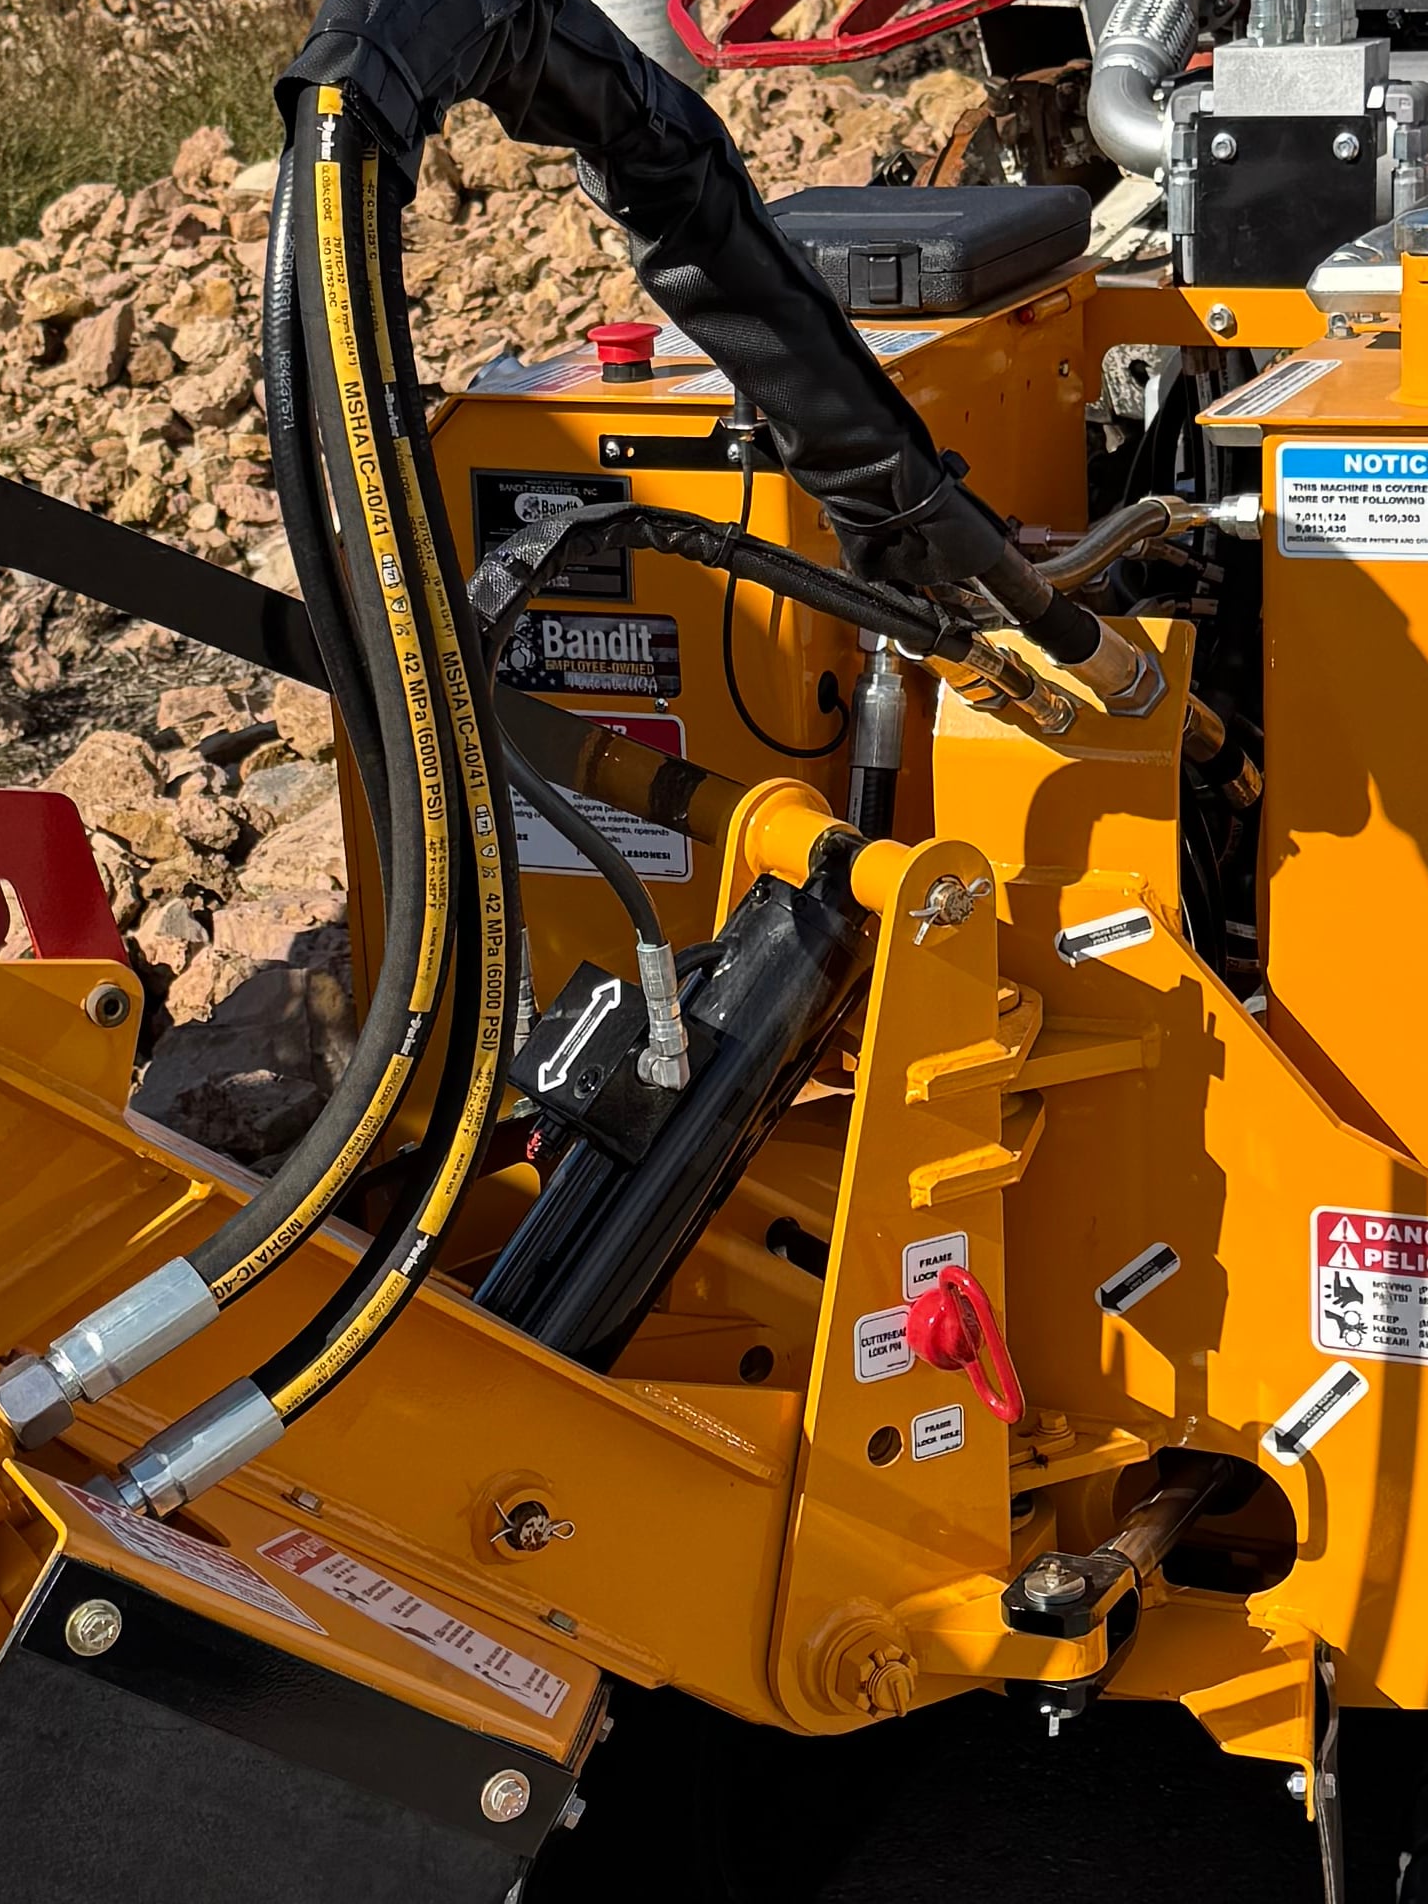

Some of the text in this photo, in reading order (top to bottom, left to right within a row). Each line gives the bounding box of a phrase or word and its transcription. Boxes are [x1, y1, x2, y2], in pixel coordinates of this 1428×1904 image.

[343, 380, 390, 537] MSHA IC-40/41
[500, 484, 529, 492] BANDIT
[1293, 483, 1317, 492] THIS
[1321, 484, 1368, 492] MACHINE
[1289, 496, 1318, 504] MORE
[1322, 496, 1335, 504] OF
[1339, 496, 1359, 504] THE
[1362, 497, 1424, 506] FOLLOWING
[542, 620, 654, 663] Bandit
[545, 660, 654, 675] EMPLOYEE-OWNED
[442, 651, 486, 790] MSHA IC-40/41
[403, 651, 444, 824] 42 MPa (6000 PSI)
[484, 892, 501, 915] 42
[485, 917, 503, 958] MPa
[484, 962, 503, 1011] (6000
[480, 1013, 500, 1053] PSI)
[258, 1217, 304, 1265] MSHA
[920, 1253, 953, 1268] FRAME
[913, 1269, 938, 1284] LOCK
[1372, 1281, 1412, 1292] MOVING
[1373, 1292, 1408, 1303] PARTS!
[1373, 1314, 1399, 1323] KEEP
[861, 1327, 907, 1347] CUTTERHEA
[1373, 1326, 1408, 1336] HANDS
[869, 1341, 902, 1358] LOCK PIN
[1373, 1337, 1410, 1346] CLEAR!
